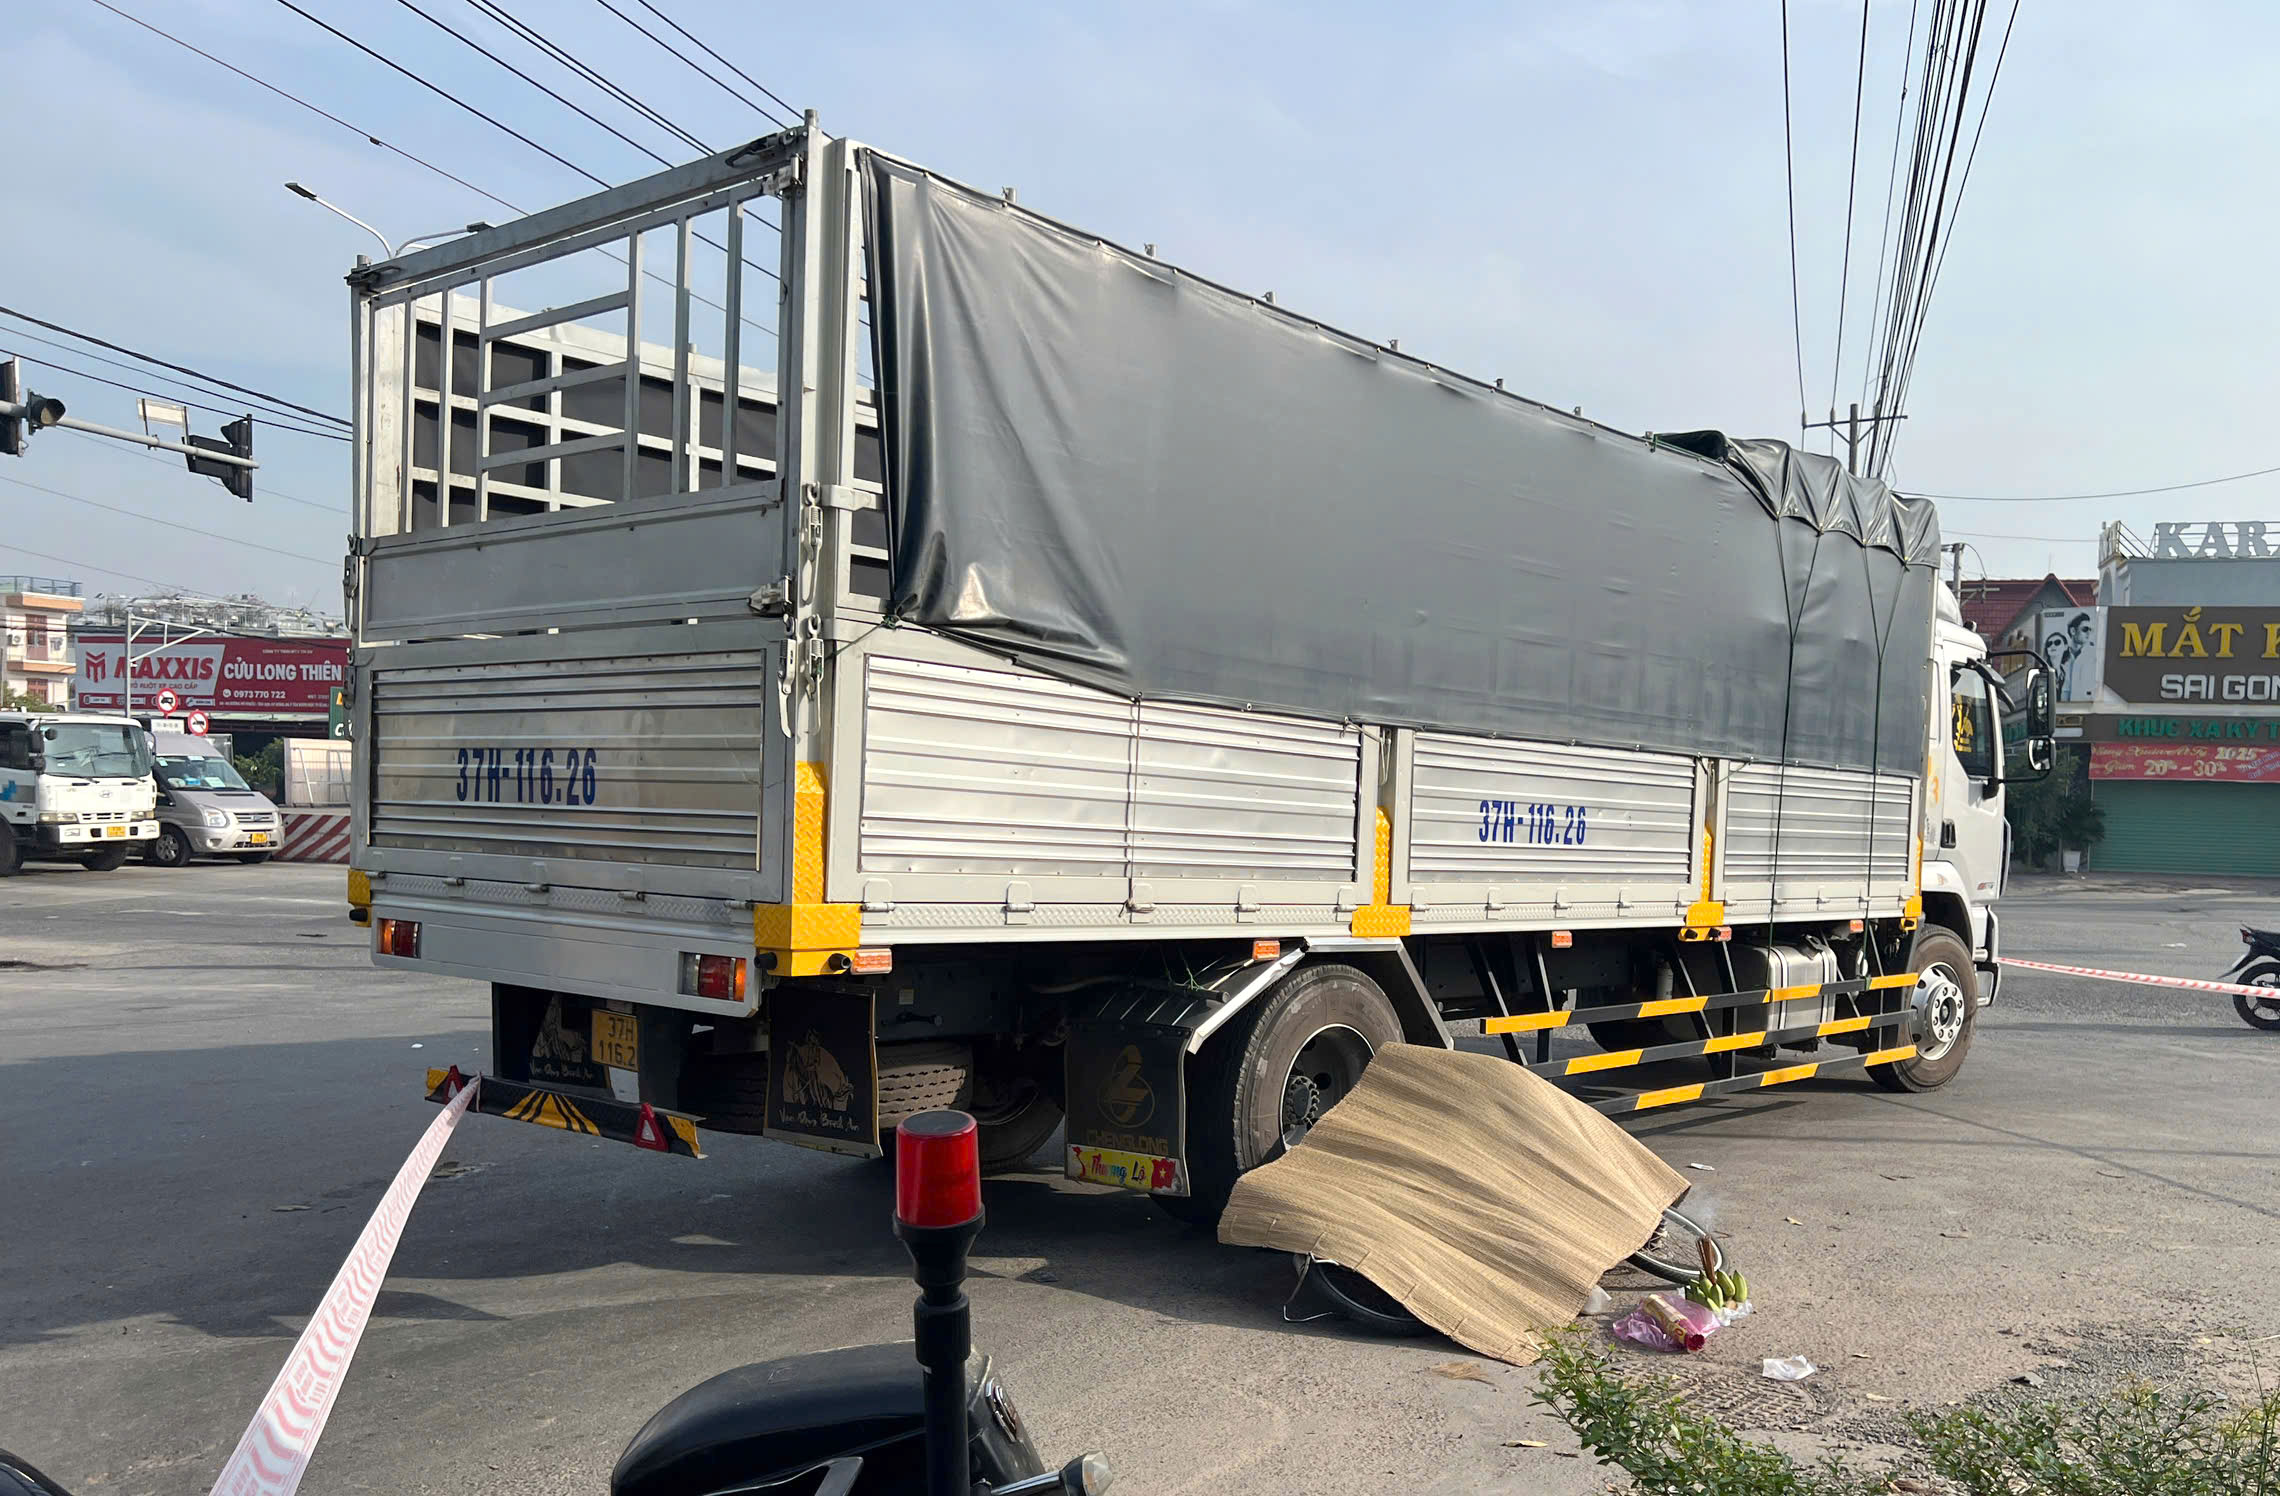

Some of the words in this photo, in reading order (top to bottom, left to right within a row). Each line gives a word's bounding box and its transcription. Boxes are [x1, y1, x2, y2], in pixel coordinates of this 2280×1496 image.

[2156, 521, 2280, 559] KAR
[2120, 606, 2244, 657] MẮT
[114, 656, 213, 680] MAXXIS
[224, 657, 253, 680] CỬU
[256, 664, 297, 680] LONG
[300, 660, 341, 680] THIÊN
[255, 691, 269, 699] 770
[271, 691, 286, 699] 722
[2160, 674, 2215, 699] SAI
[456, 748, 597, 806] 37H-116.26
[1479, 800, 1586, 845] 37H-116.26
[608, 1016, 634, 1042] 37H
